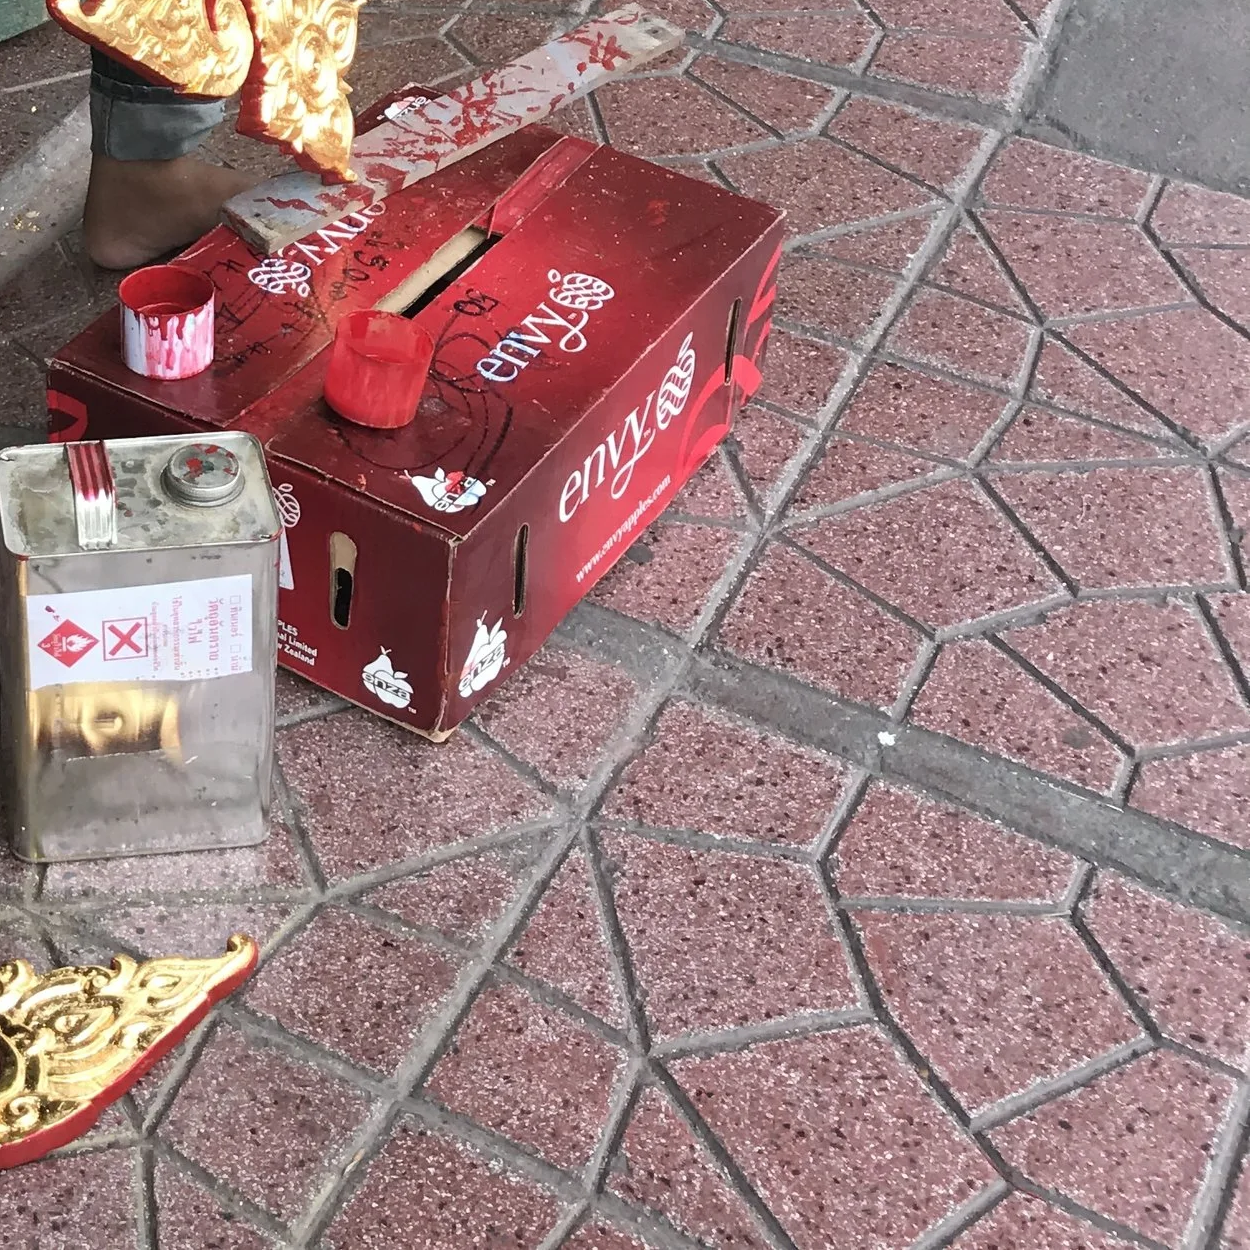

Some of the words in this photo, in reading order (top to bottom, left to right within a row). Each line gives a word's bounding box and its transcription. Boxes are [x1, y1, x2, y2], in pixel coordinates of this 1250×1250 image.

[476, 301, 590, 383] envy
[558, 389, 657, 524] envy
[433, 476, 478, 512] ena
[575, 473, 672, 583] www.envyapples.com
[284, 646, 316, 667] Zealand
[288, 634, 318, 658] Limited
[361, 671, 412, 701] enza
[459, 643, 507, 693] enza
